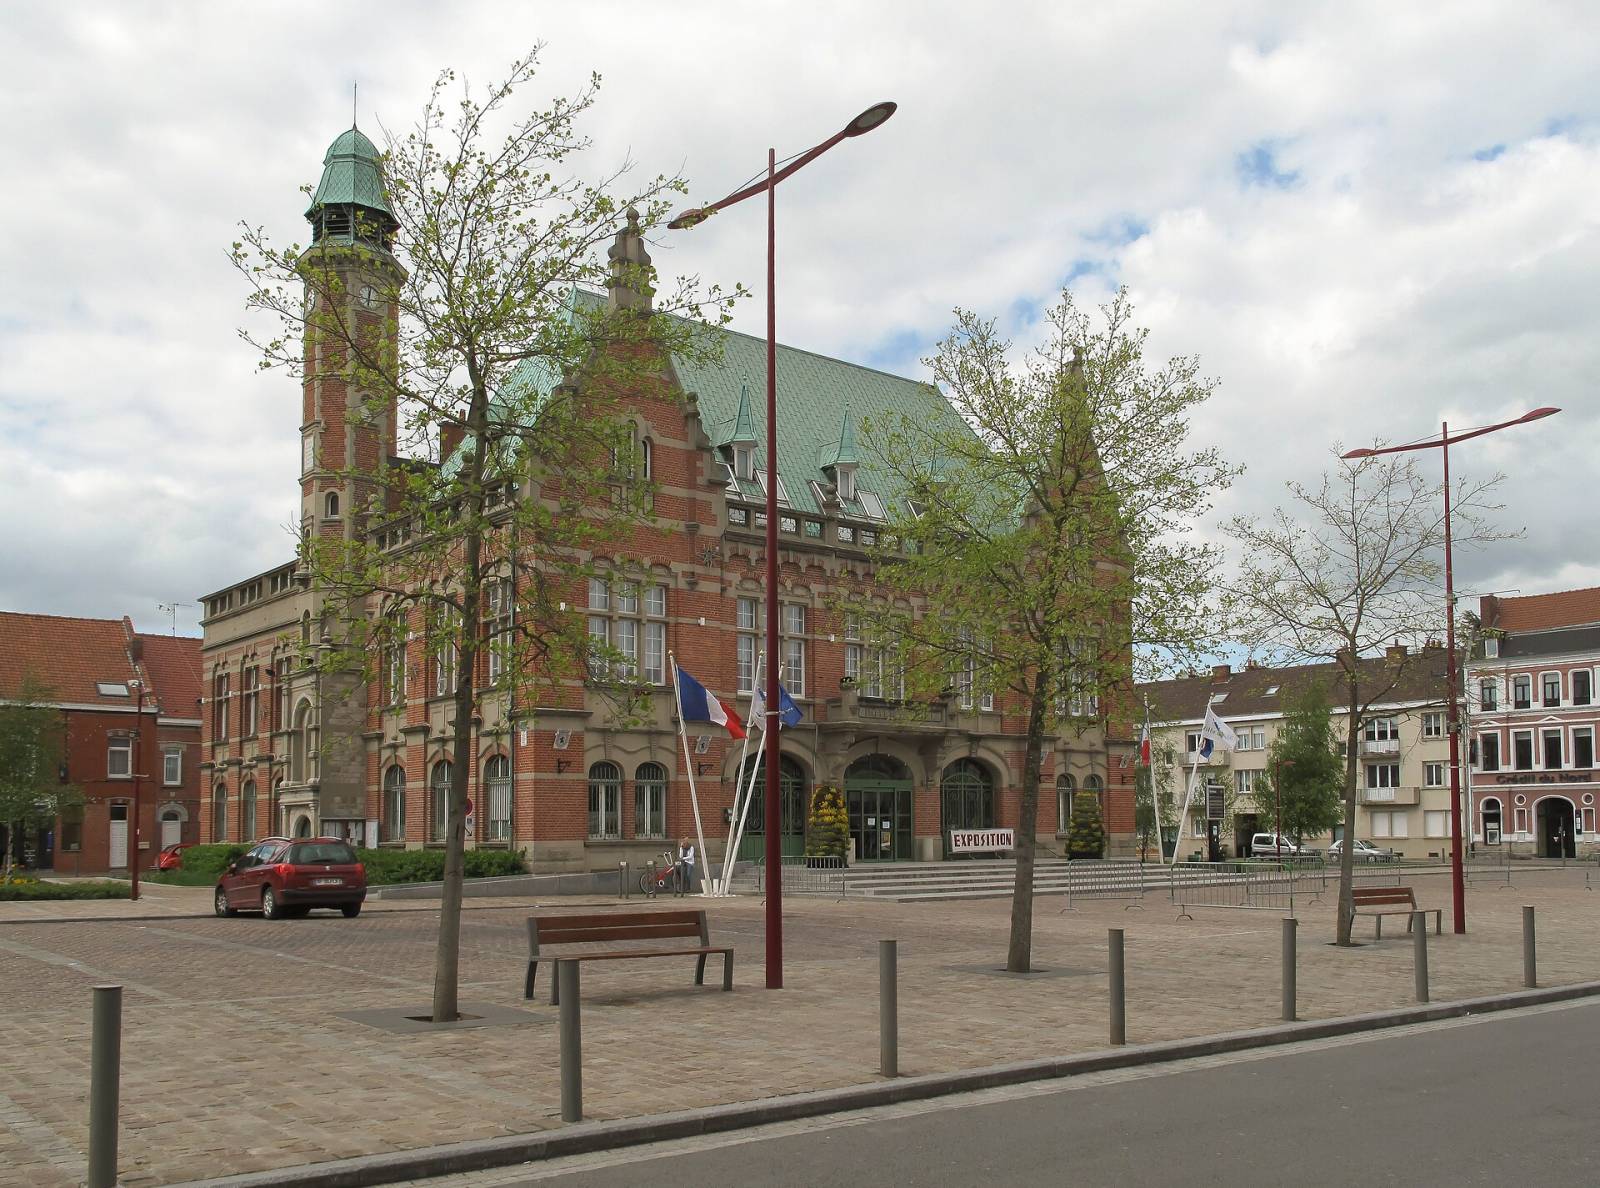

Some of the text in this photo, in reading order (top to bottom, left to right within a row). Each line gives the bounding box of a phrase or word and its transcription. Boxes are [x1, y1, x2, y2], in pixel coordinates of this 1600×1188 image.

[1539, 773, 1555, 784] du
[1559, 772, 1592, 783] Nord
[953, 833, 1012, 847] EXPOSITION
